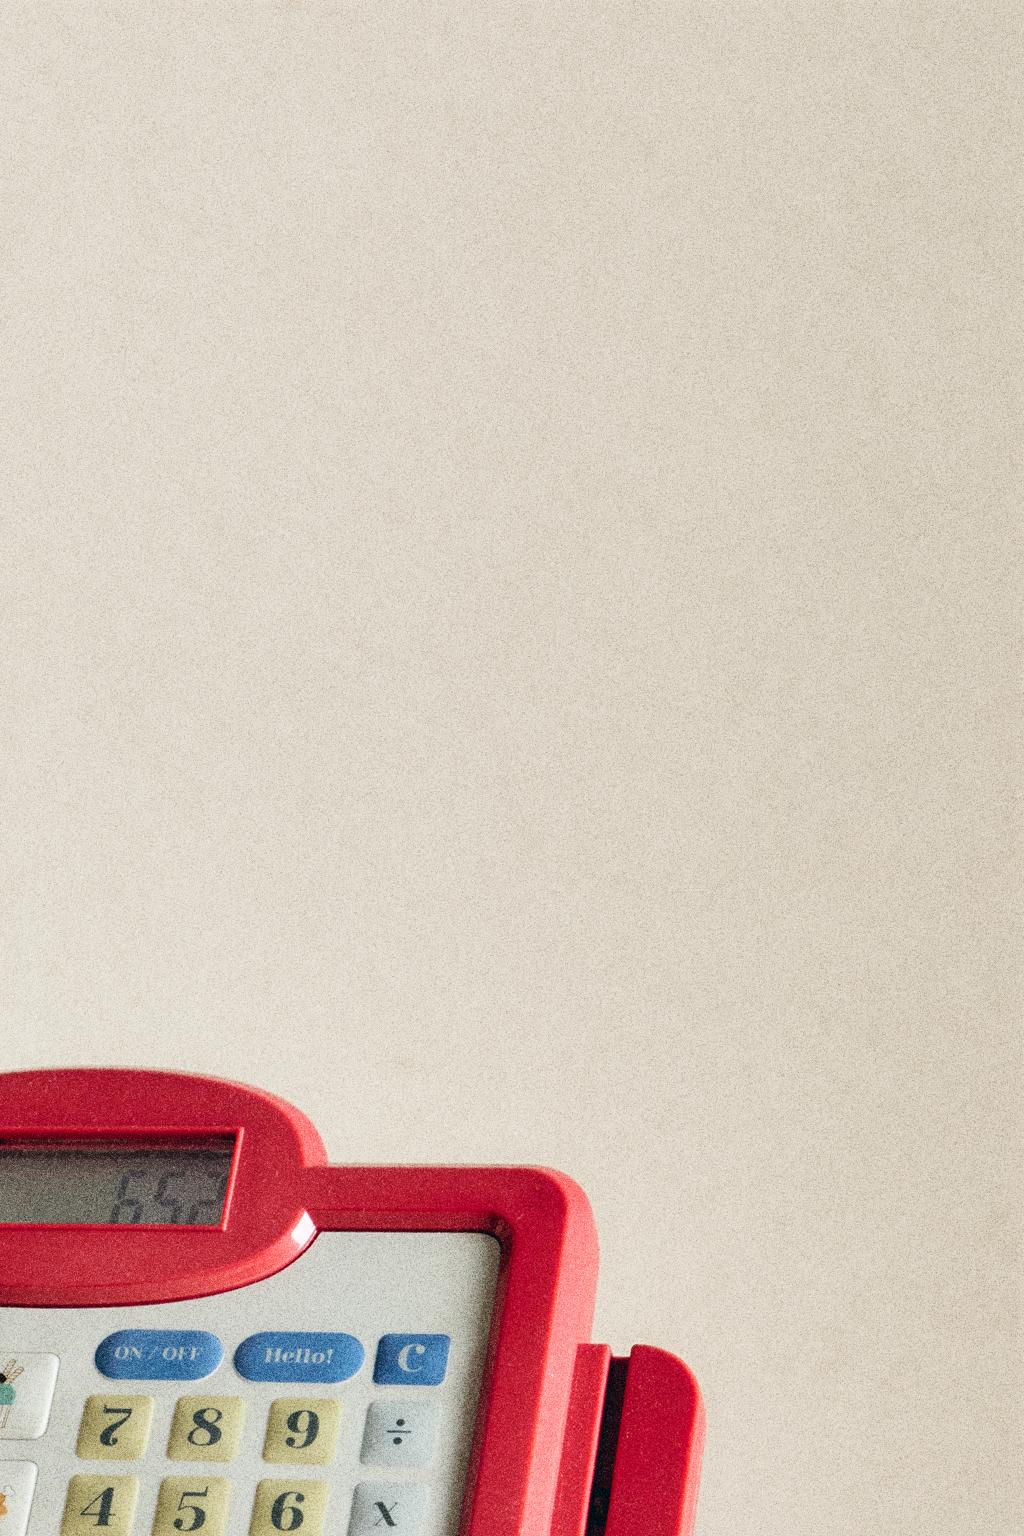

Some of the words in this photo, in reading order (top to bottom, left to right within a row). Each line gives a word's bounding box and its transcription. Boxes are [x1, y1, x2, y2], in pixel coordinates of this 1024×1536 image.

[114, 1345, 144, 1360] ON
[162, 1345, 203, 1361] OFF
[264, 1347, 333, 1364] Hello!
[397, 1343, 426, 1373] C
[100, 1404, 132, 1447] 7
[187, 1408, 222, 1447] 8
[285, 1410, 320, 1449] 9
[80, 1487, 115, 1527] 4
[173, 1486, 208, 1532] 5
[271, 1491, 305, 1532] 6
